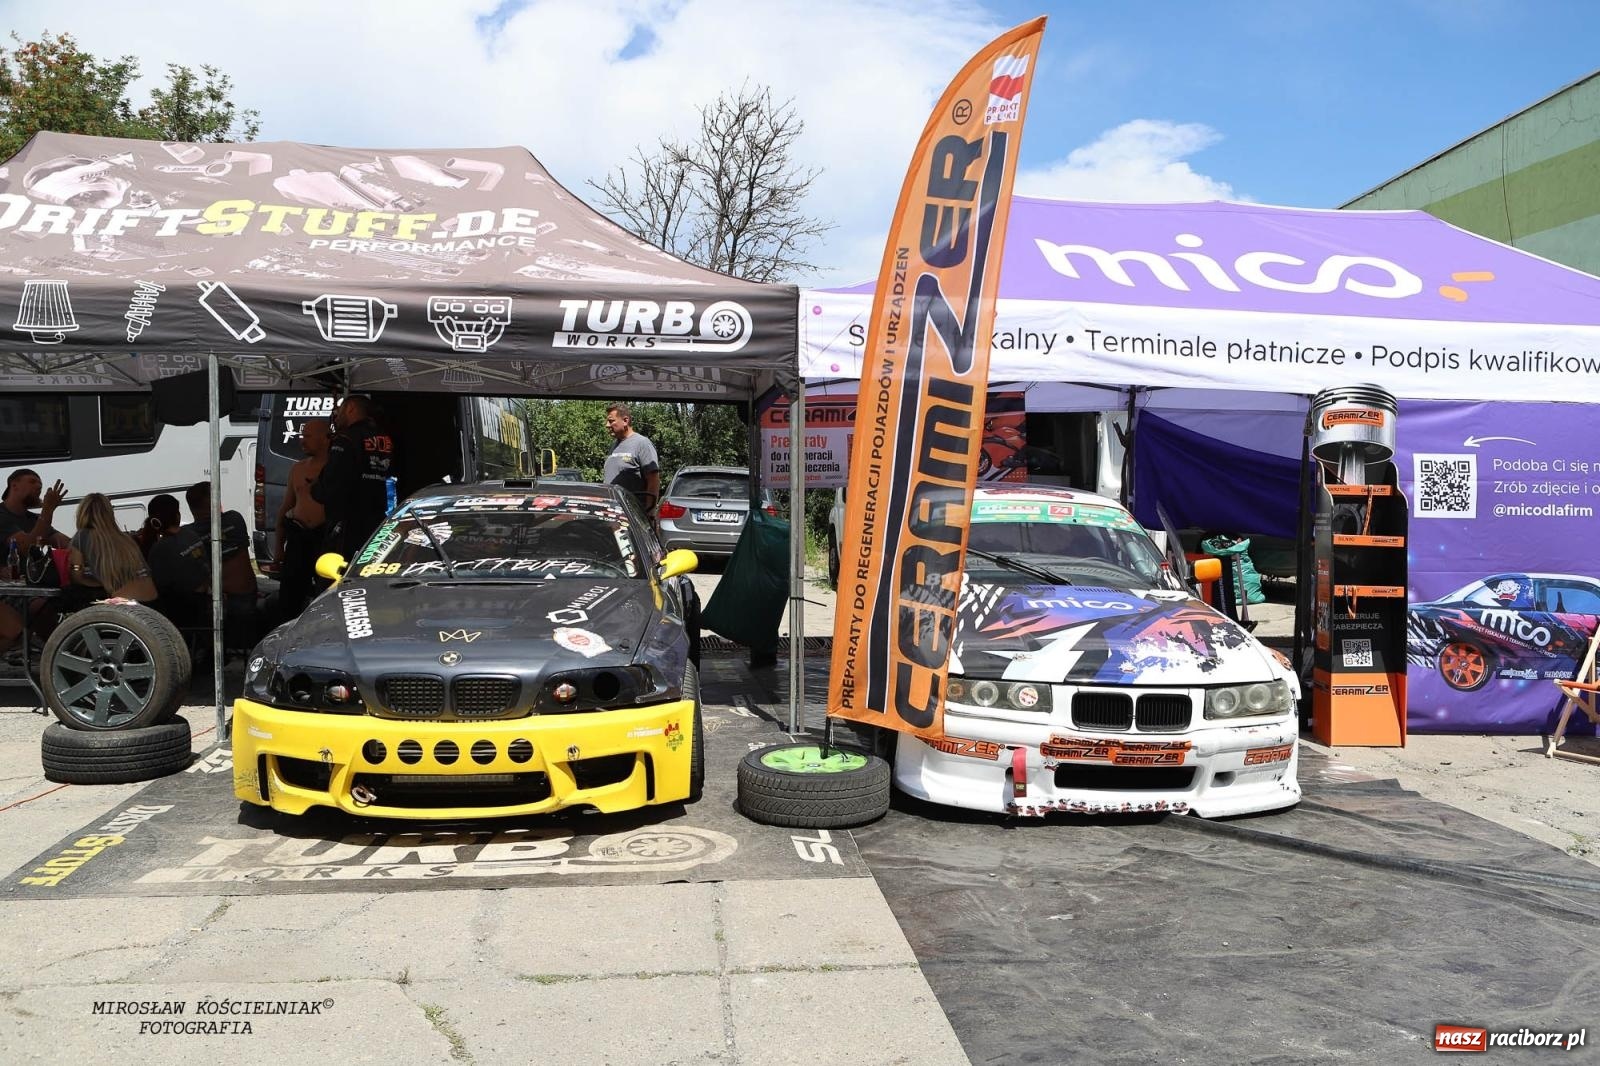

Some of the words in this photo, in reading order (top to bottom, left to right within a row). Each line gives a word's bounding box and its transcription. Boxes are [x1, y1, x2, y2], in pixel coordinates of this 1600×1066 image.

[309, 235, 537, 252] PERFORMANCE
[1034, 233, 1423, 298] mico
[887, 247, 910, 345] URZĄDZEŃ
[567, 334, 656, 347] WORKS
[1085, 330, 1216, 358] Terminale
[1227, 337, 1346, 365] płatnicze
[1371, 345, 1460, 372] Podpis
[871, 359, 894, 459] POJAZDÓW
[1327, 411, 1380, 421] CERAMIZER
[770, 451, 782, 461] do
[1493, 458, 1548, 472] Podoba
[1552, 459, 1566, 472] Ci
[1570, 459, 1589, 474] się
[1493, 481, 1528, 494] Zrób
[1532, 481, 1580, 496] zdjęcie
[1492, 503, 1593, 517] @micodlafirm
[857, 461, 881, 580] REGENERACJI
[359, 562, 402, 578] 668
[855, 584, 866, 610] DO
[1027, 596, 1134, 612] mico
[1480, 609, 1552, 647] mico
[841, 614, 864, 709] PREPARATY
[1041, 747, 1109, 758] CERAMIZER
[1115, 753, 1180, 764] CERAMIZER
